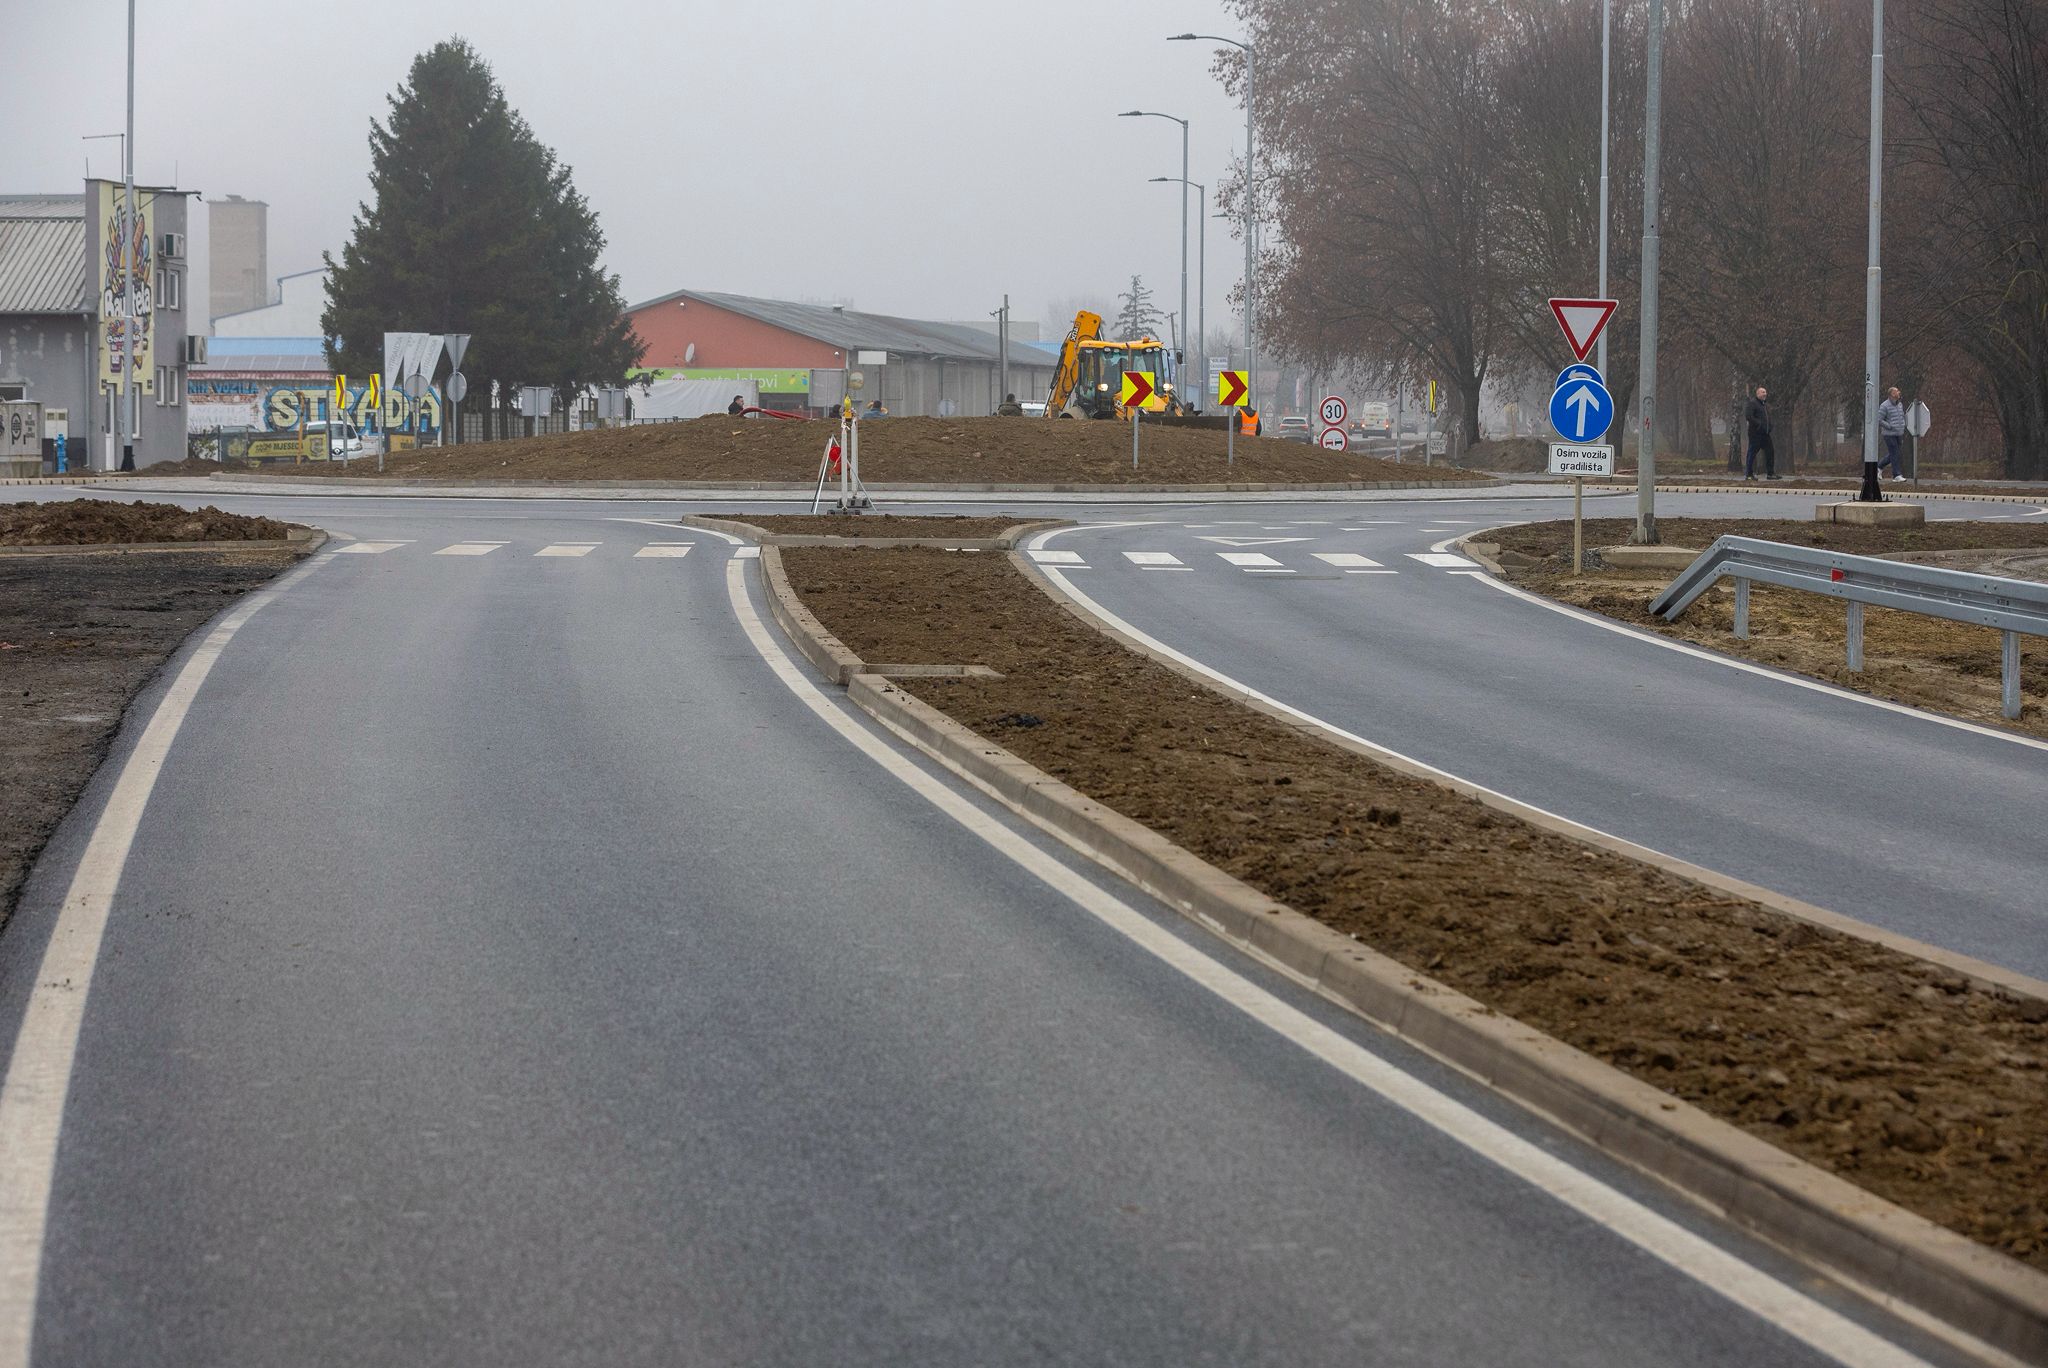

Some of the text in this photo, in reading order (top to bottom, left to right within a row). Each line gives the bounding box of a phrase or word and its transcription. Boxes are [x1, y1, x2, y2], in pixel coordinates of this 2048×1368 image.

[1325, 404, 1342, 419] 30
[1556, 448, 1607, 459] Osim vozila
[1560, 462, 1603, 472] gradilišta
